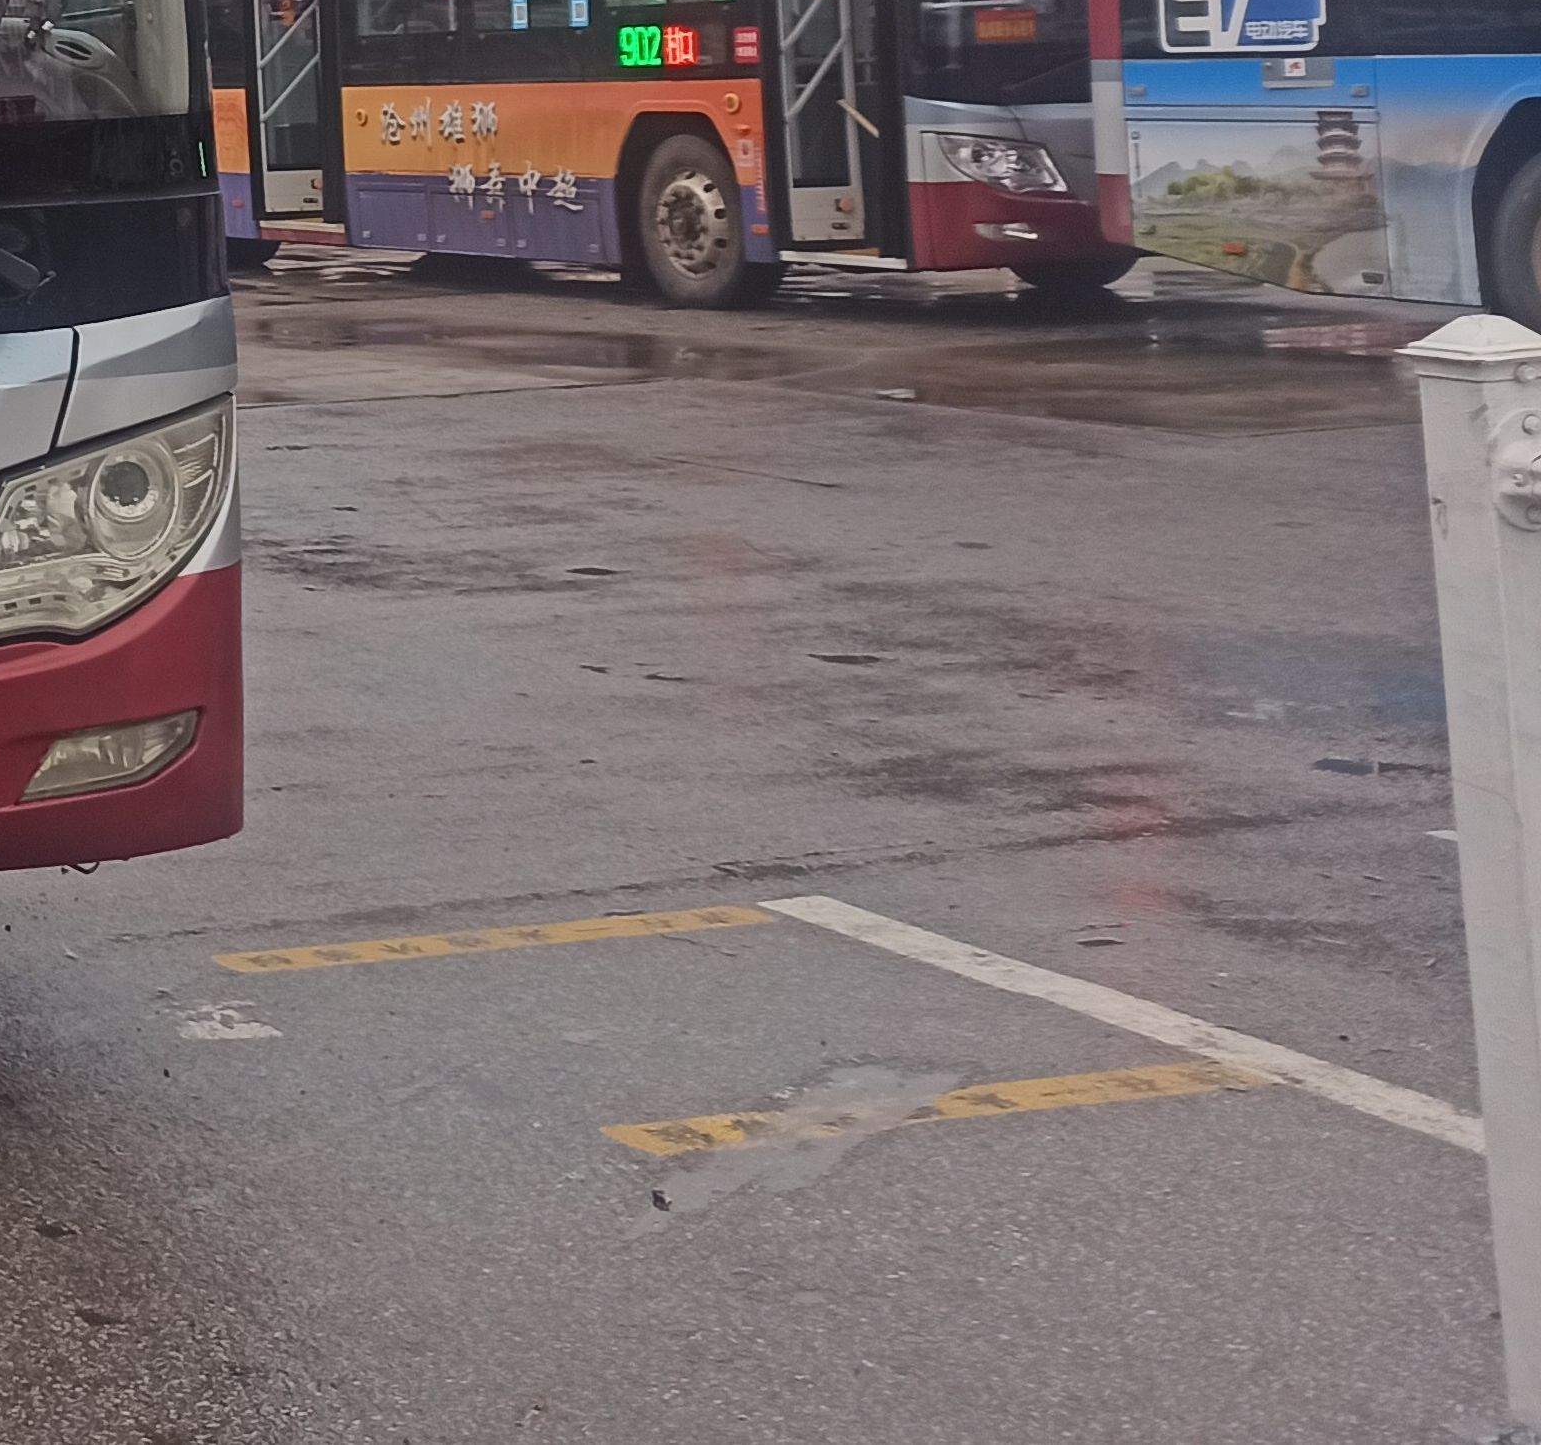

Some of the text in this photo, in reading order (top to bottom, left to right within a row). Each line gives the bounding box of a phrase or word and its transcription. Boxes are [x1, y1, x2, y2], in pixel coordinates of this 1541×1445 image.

[619, 26, 662, 66] 902
[1244, 20, 1309, 40] 电动汽车
[380, 97, 498, 149] 沧州雄狮
